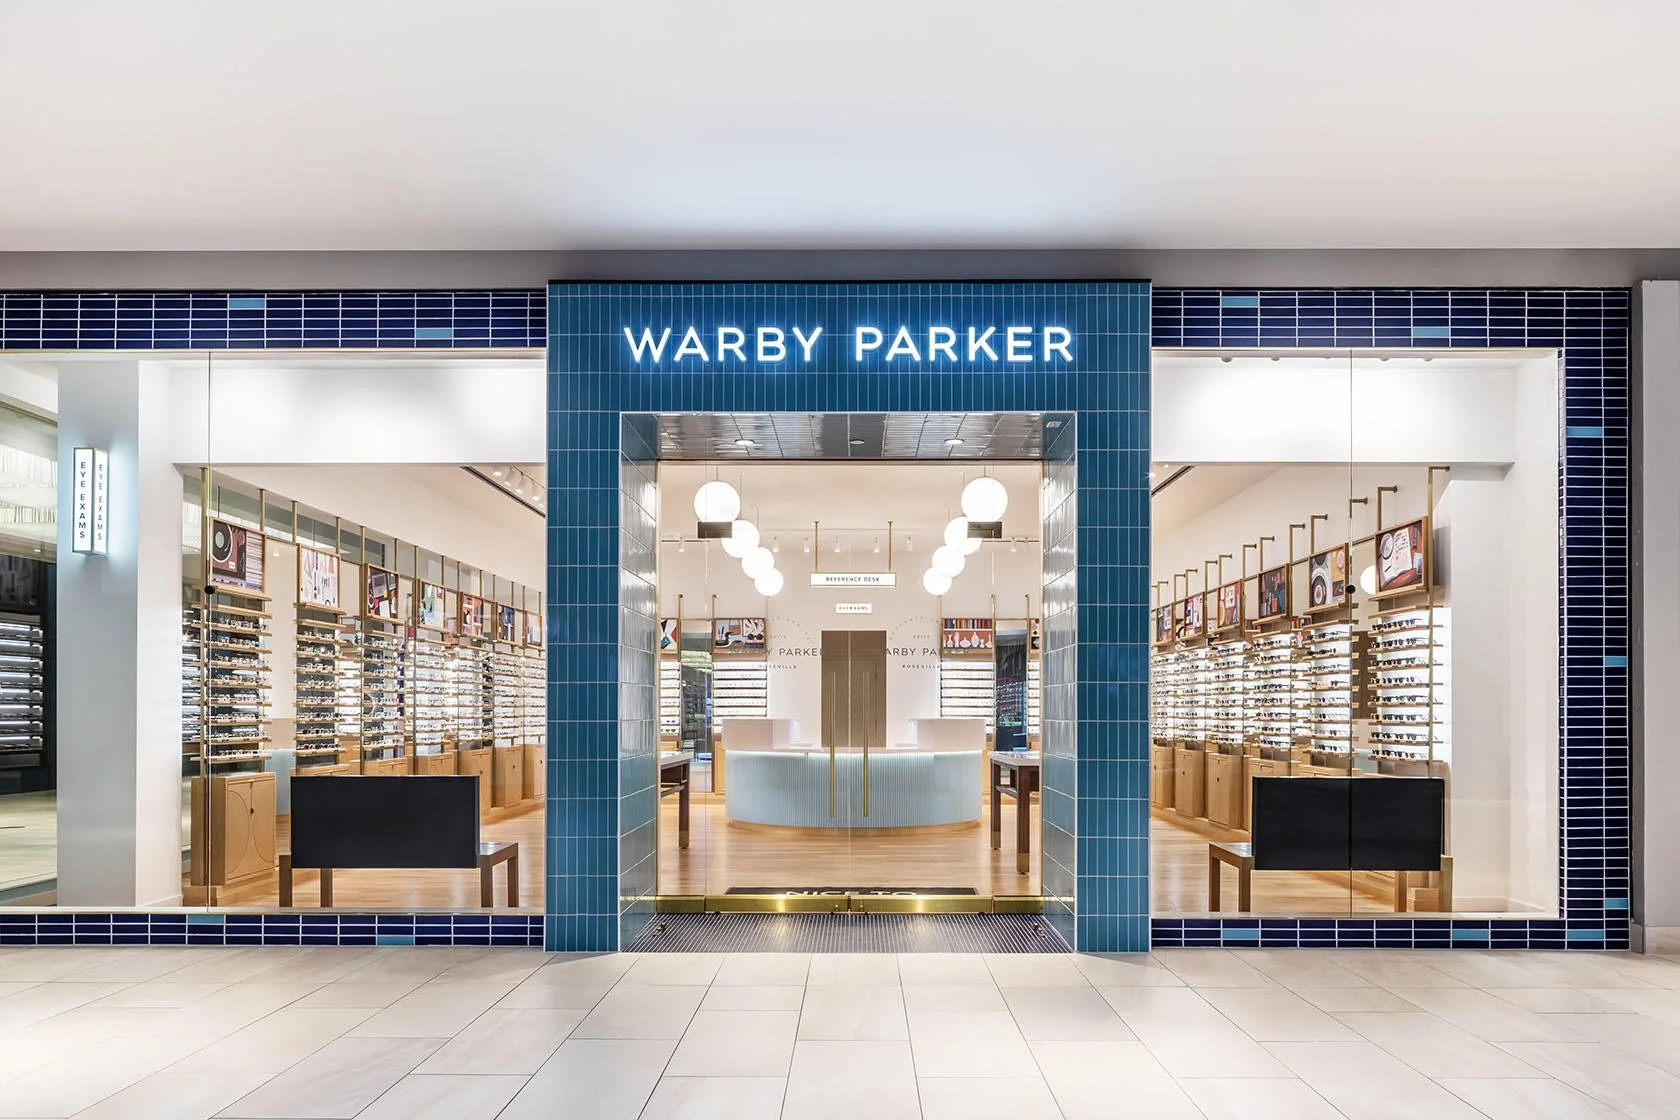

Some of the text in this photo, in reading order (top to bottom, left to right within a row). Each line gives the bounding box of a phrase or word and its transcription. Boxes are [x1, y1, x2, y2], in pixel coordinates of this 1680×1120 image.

[623, 326, 1074, 363] WARBY PARKER
[78, 493, 87, 539] EXAMS
[879, 647, 917, 656] ARBY
